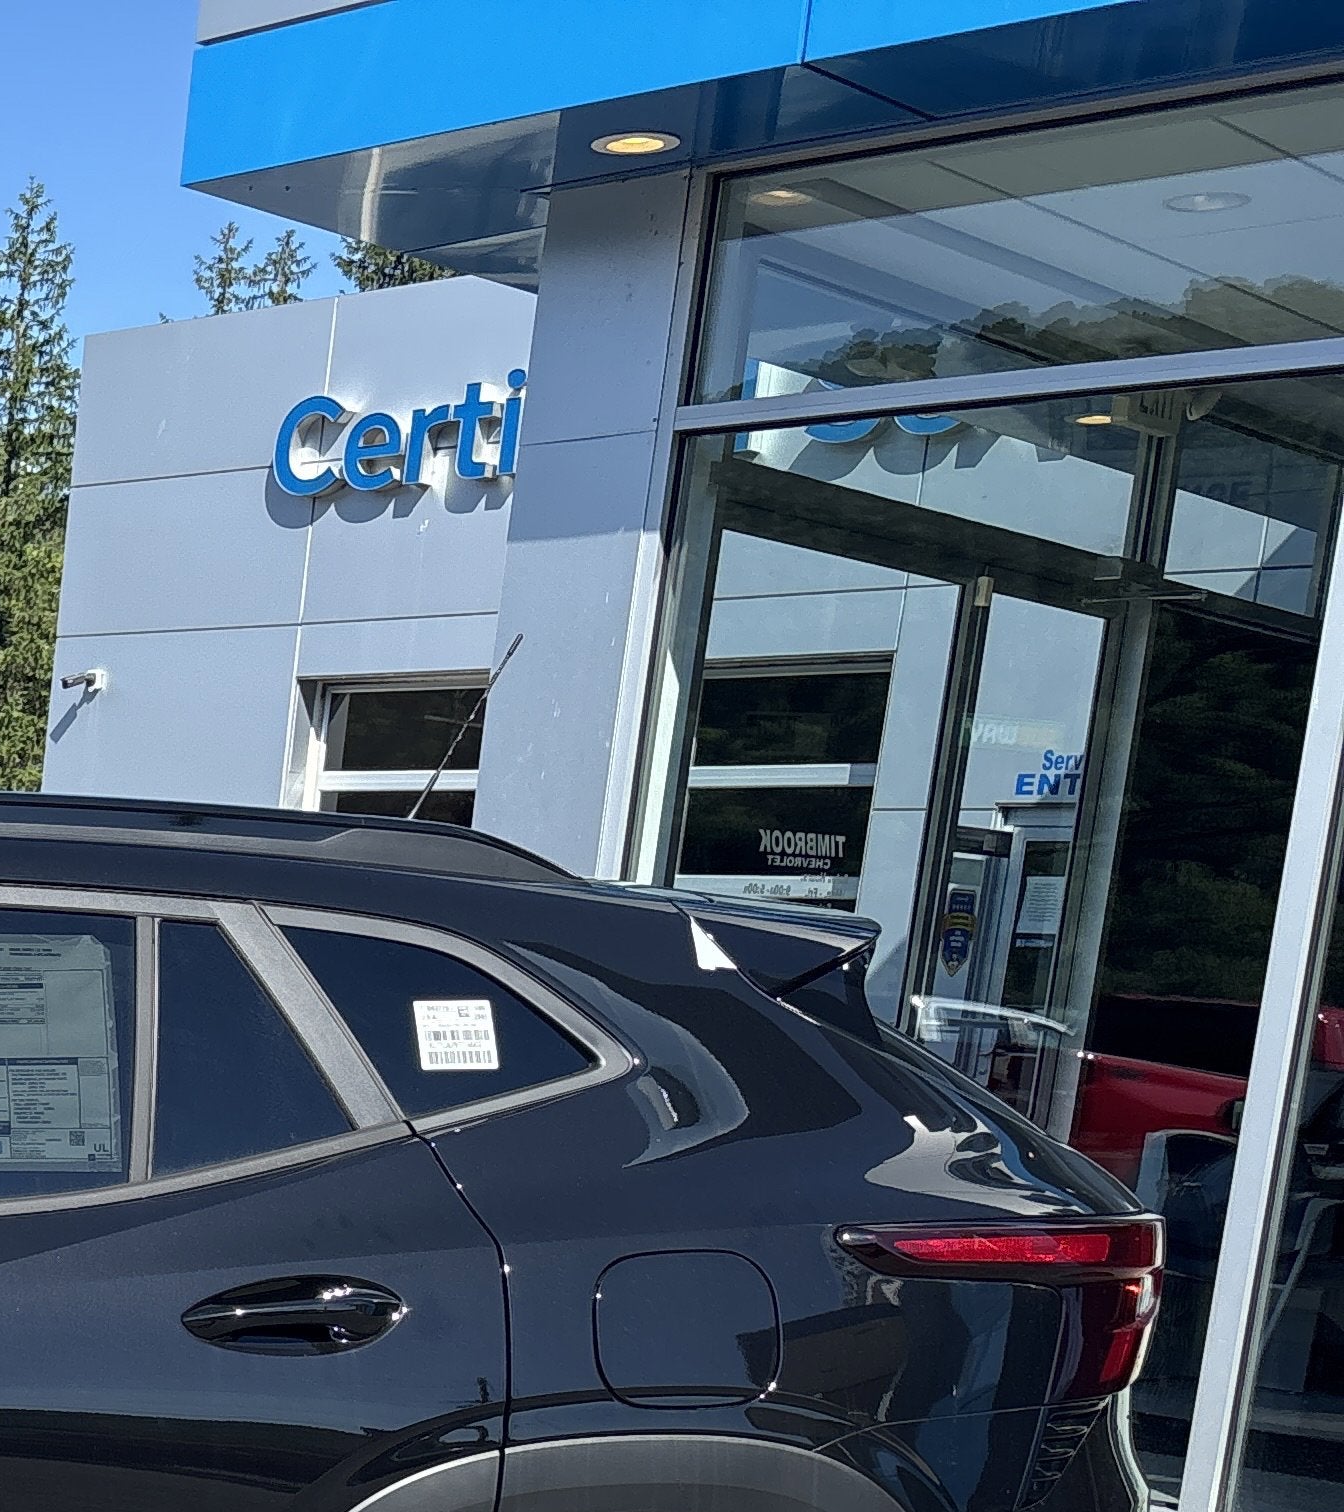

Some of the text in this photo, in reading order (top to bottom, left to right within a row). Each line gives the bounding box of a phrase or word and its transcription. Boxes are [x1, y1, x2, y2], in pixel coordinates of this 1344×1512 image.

[273, 369, 528, 497] Certi
[1042, 750, 1085, 771] Serv
[1015, 773, 1081, 796] ENT
